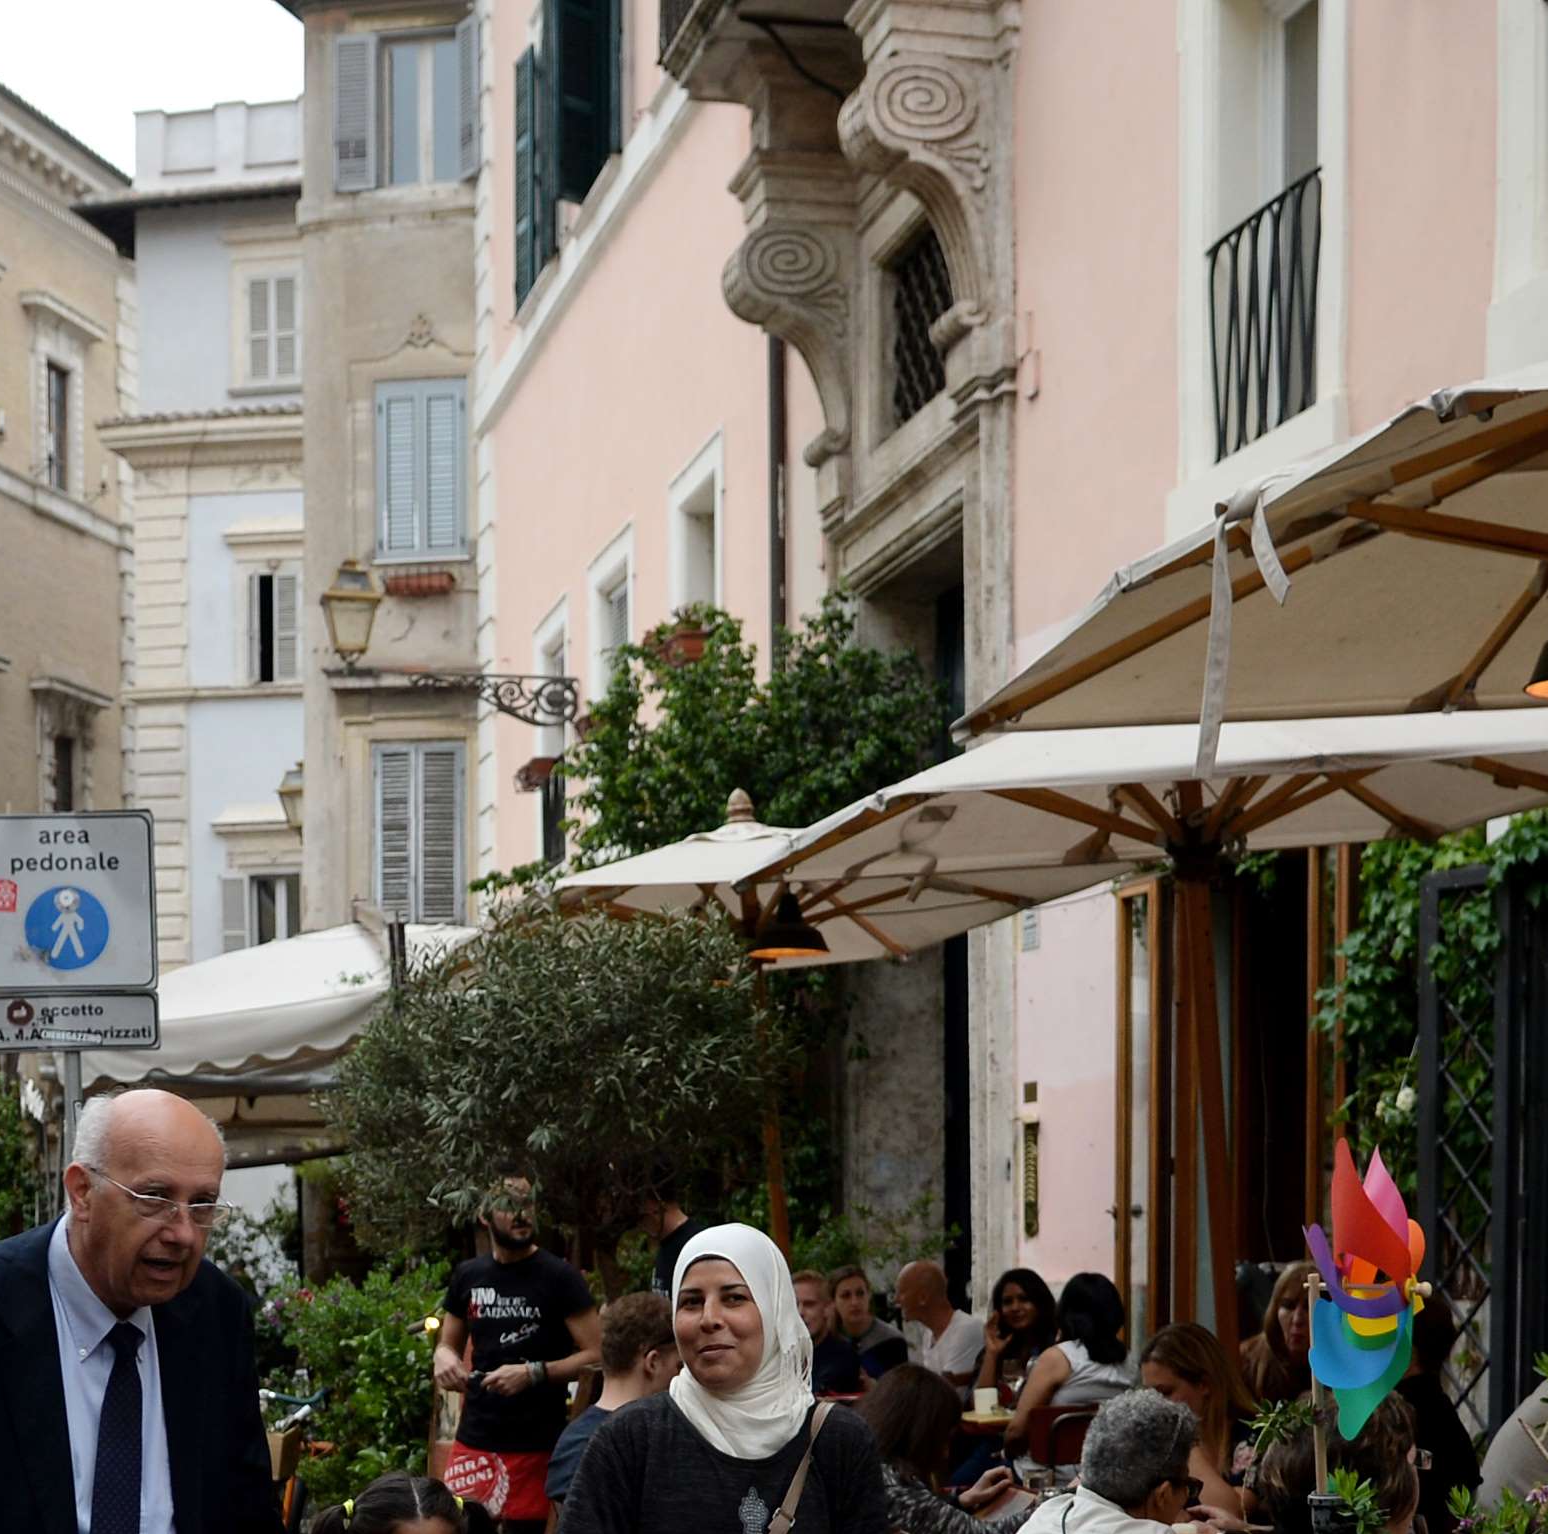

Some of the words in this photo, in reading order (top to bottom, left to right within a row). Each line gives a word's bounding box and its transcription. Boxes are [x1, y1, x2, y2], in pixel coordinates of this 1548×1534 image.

[39, 829, 89, 844] area
[11, 852, 119, 875] pedonale
[41, 1004, 103, 1016] eccetto
[471, 1288, 496, 1305] VINO
